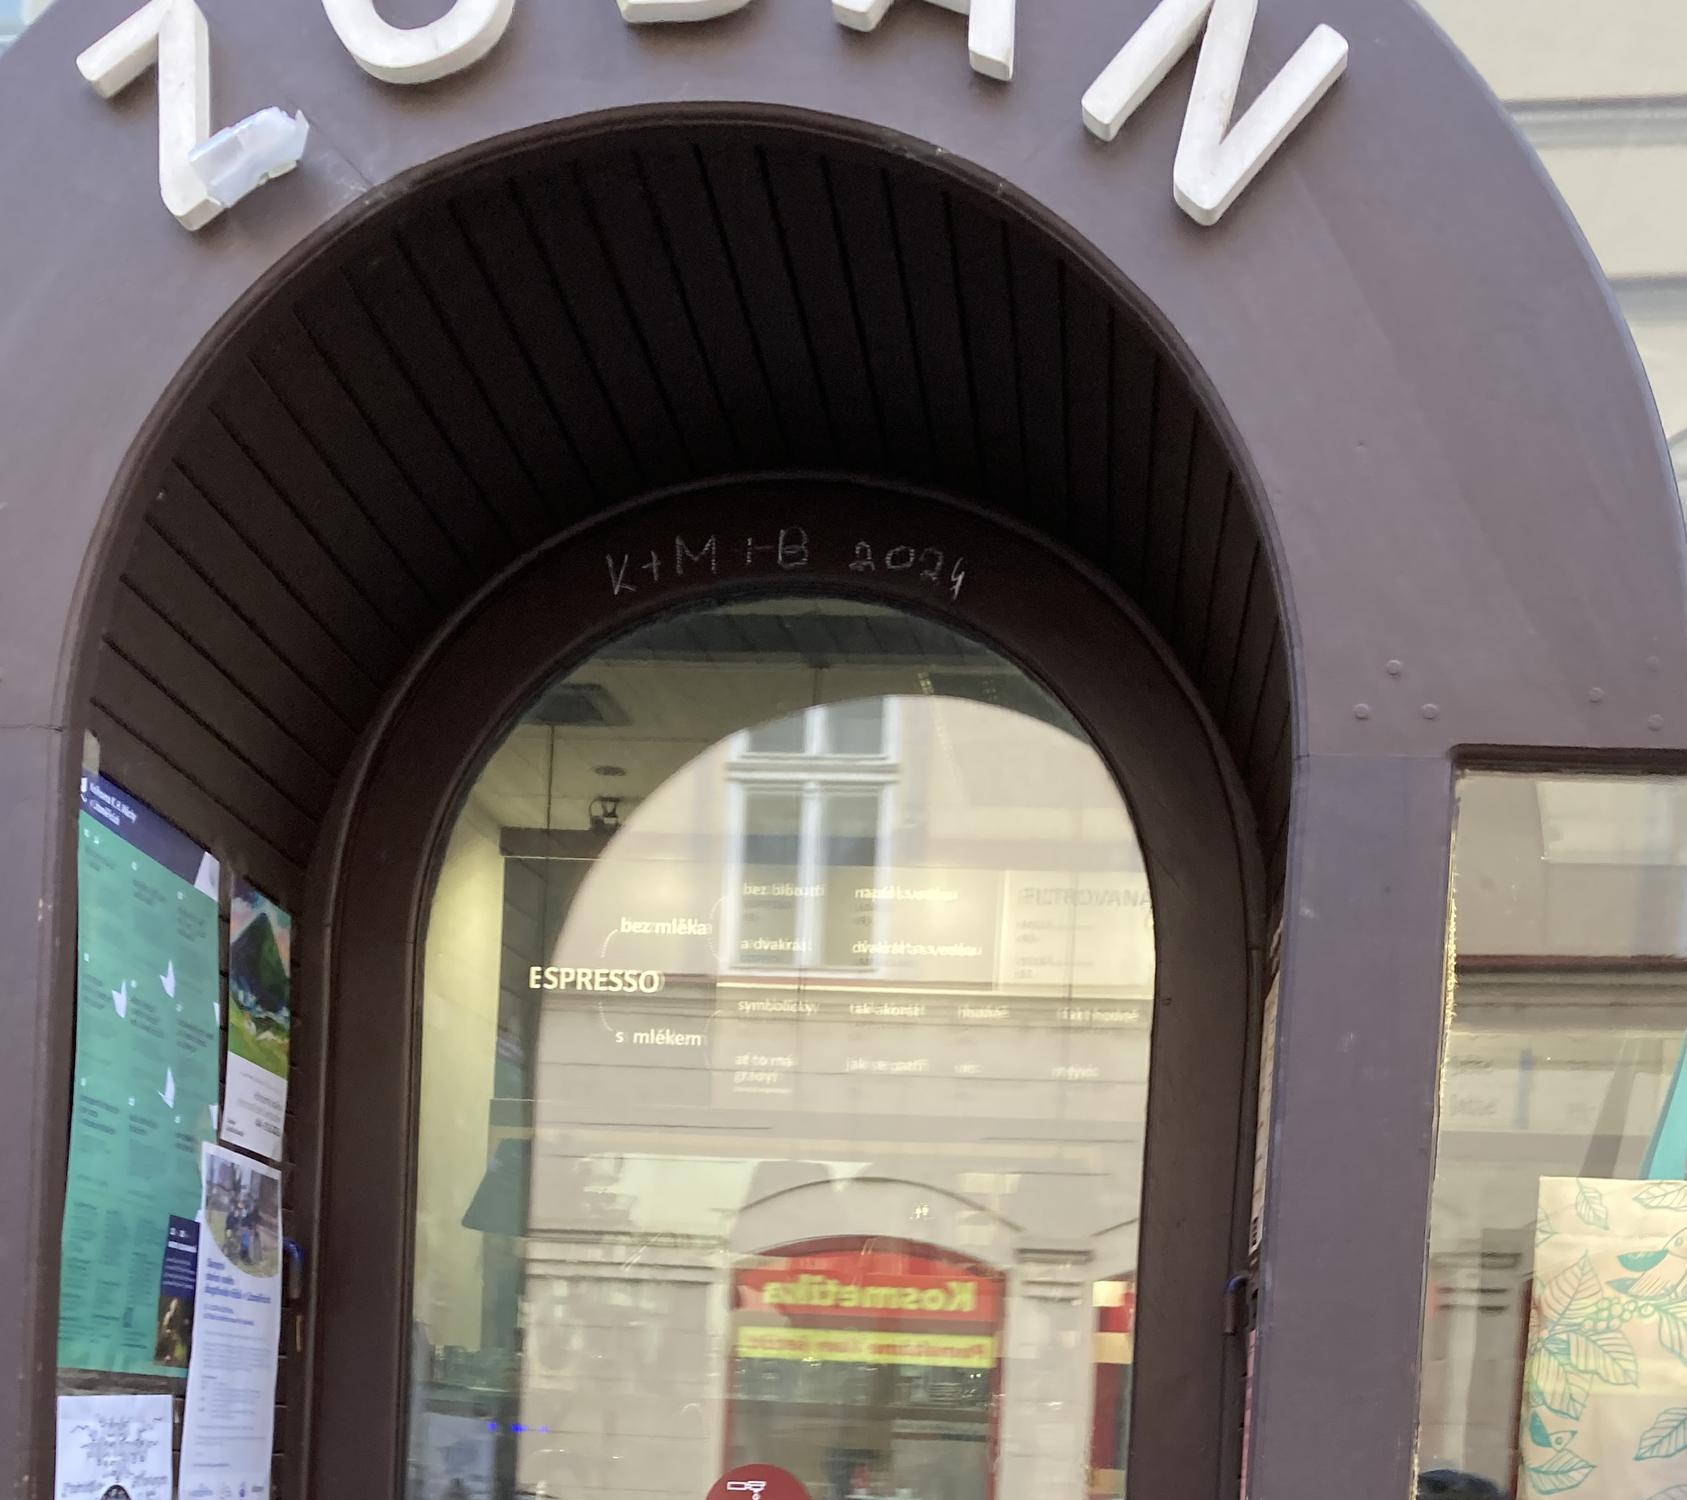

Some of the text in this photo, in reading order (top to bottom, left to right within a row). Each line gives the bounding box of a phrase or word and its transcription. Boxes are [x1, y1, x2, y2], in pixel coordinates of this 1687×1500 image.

[849, 539, 965, 600] 2024
[620, 916, 710, 936] bez mléka
[528, 966, 662, 993] ESPRESSO
[615, 1029, 702, 1046] s mlékem
